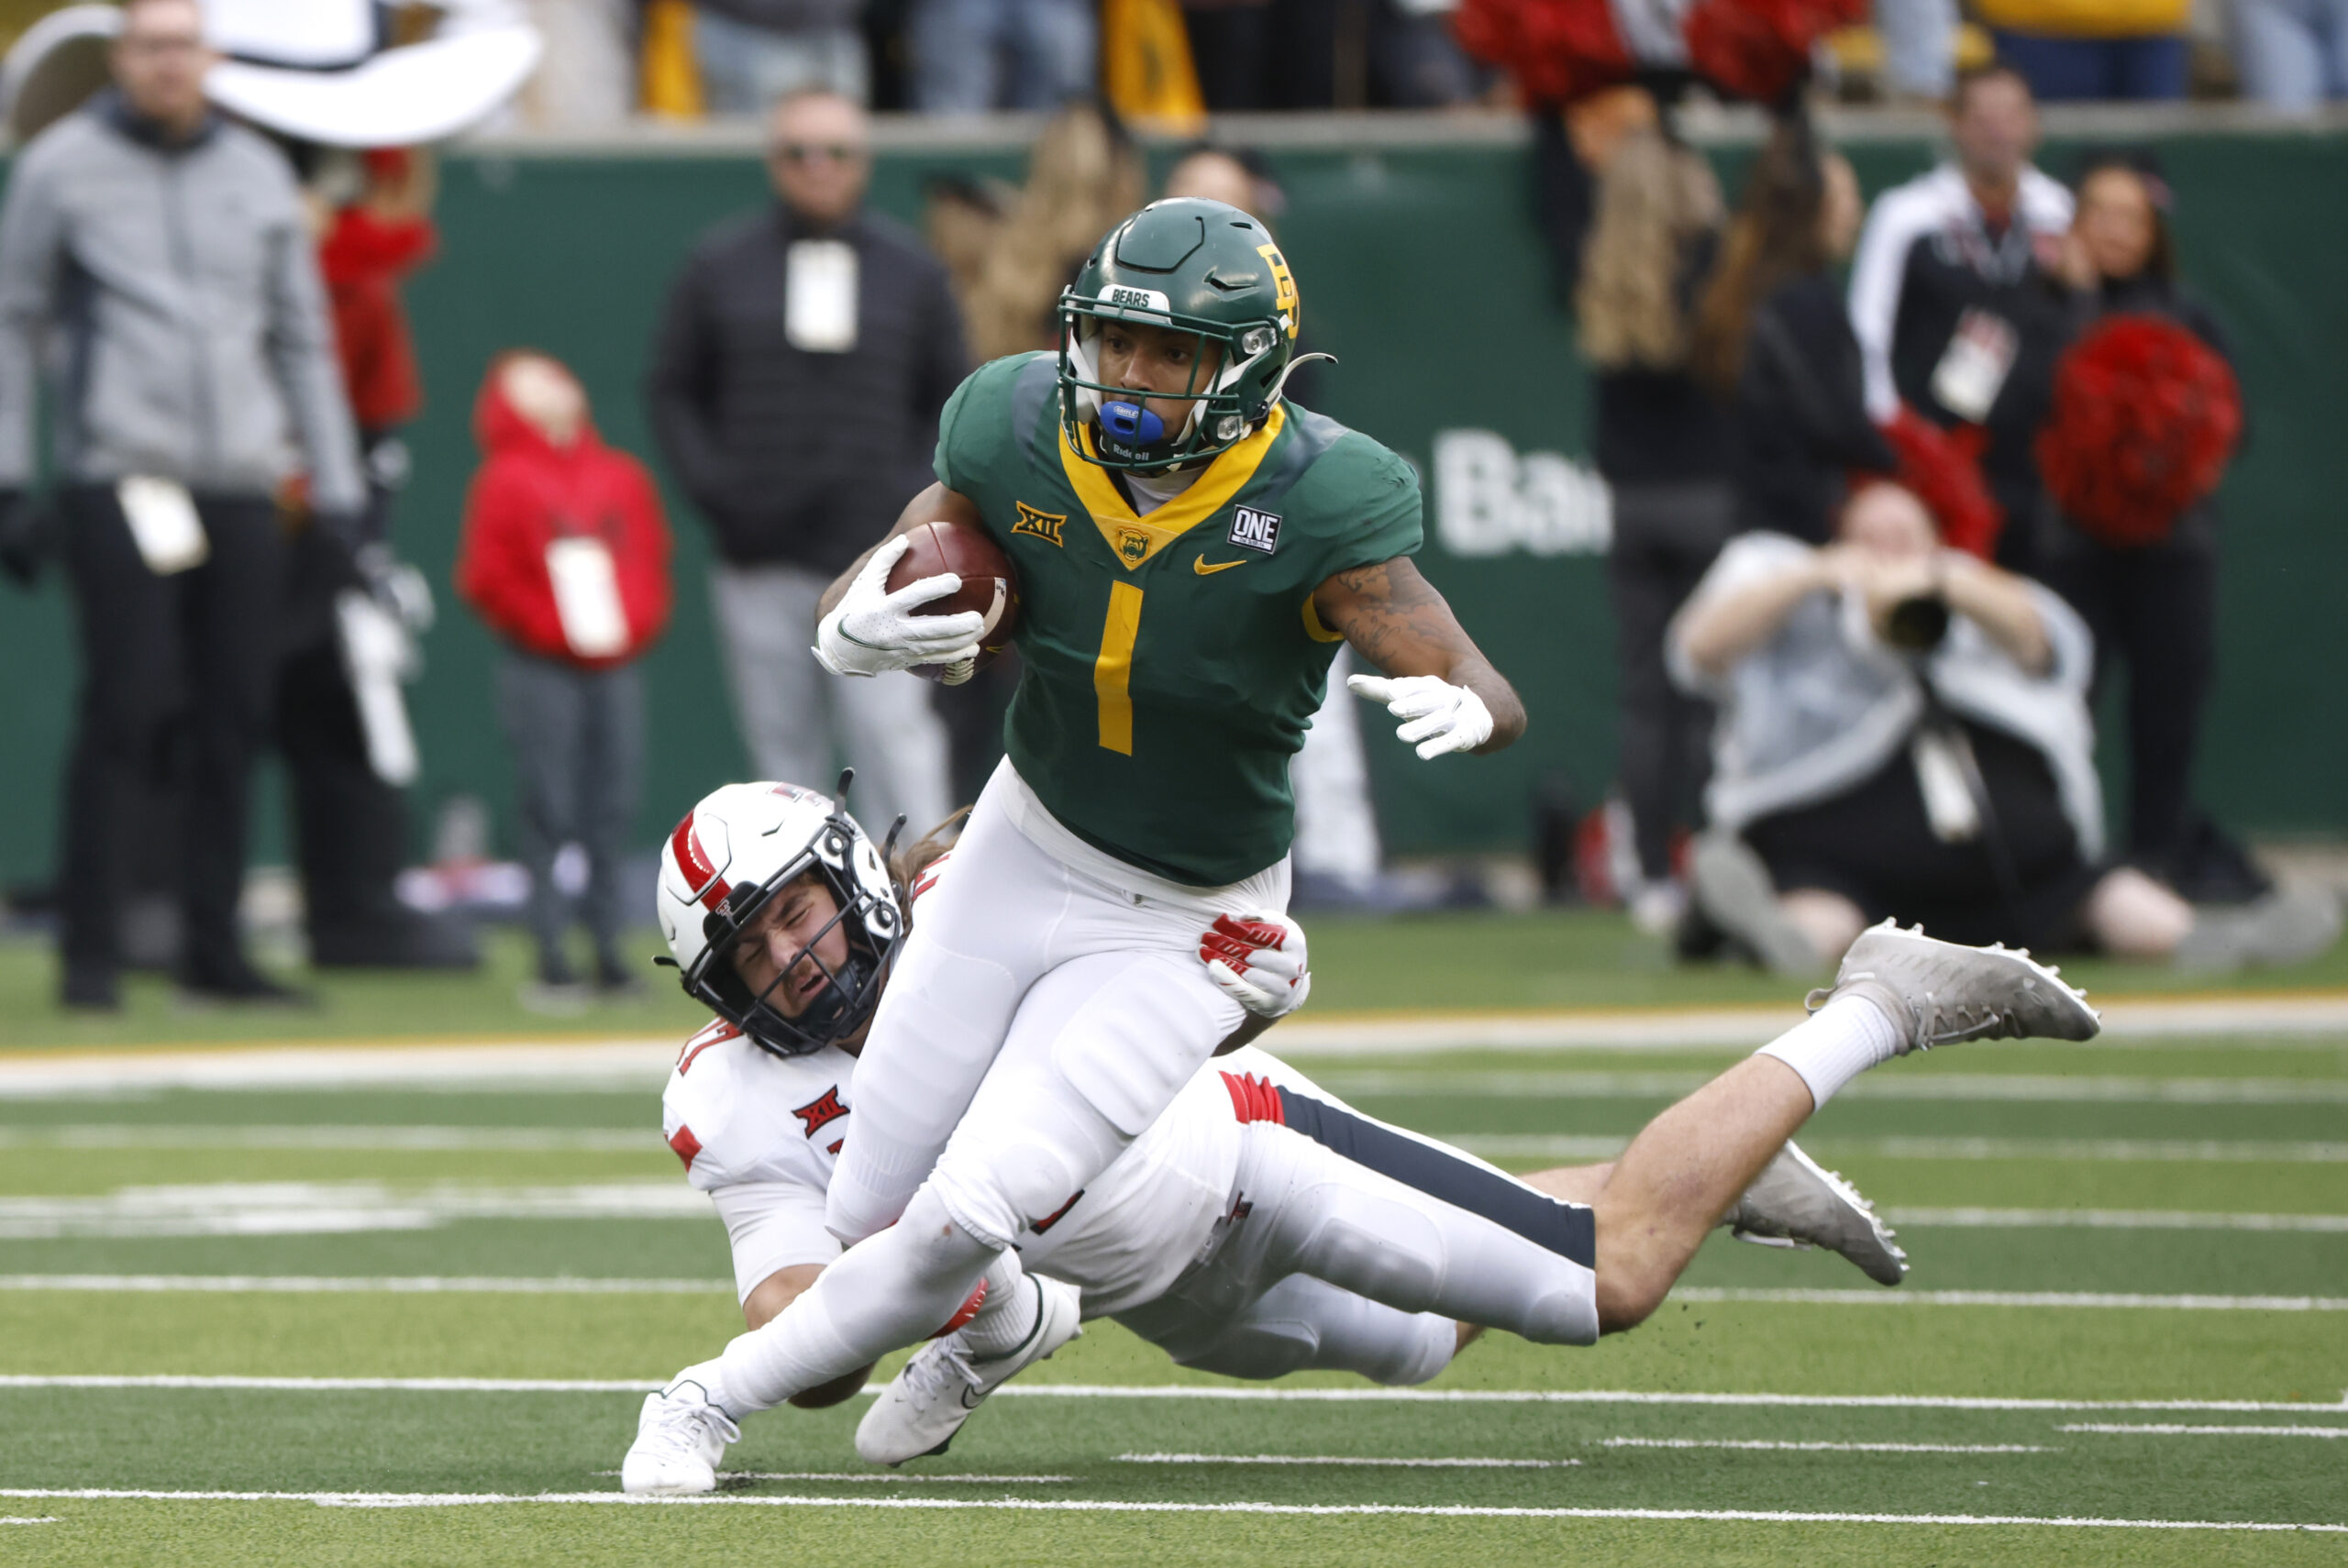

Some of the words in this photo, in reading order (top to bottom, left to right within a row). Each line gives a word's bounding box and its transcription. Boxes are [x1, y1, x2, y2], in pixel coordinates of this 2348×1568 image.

[1112, 288, 1150, 307] BEARS
[1012, 501, 1066, 547] XII
[1234, 509, 1279, 544] ONE
[1094, 580, 1144, 757] 1
[792, 1083, 851, 1140] XII
